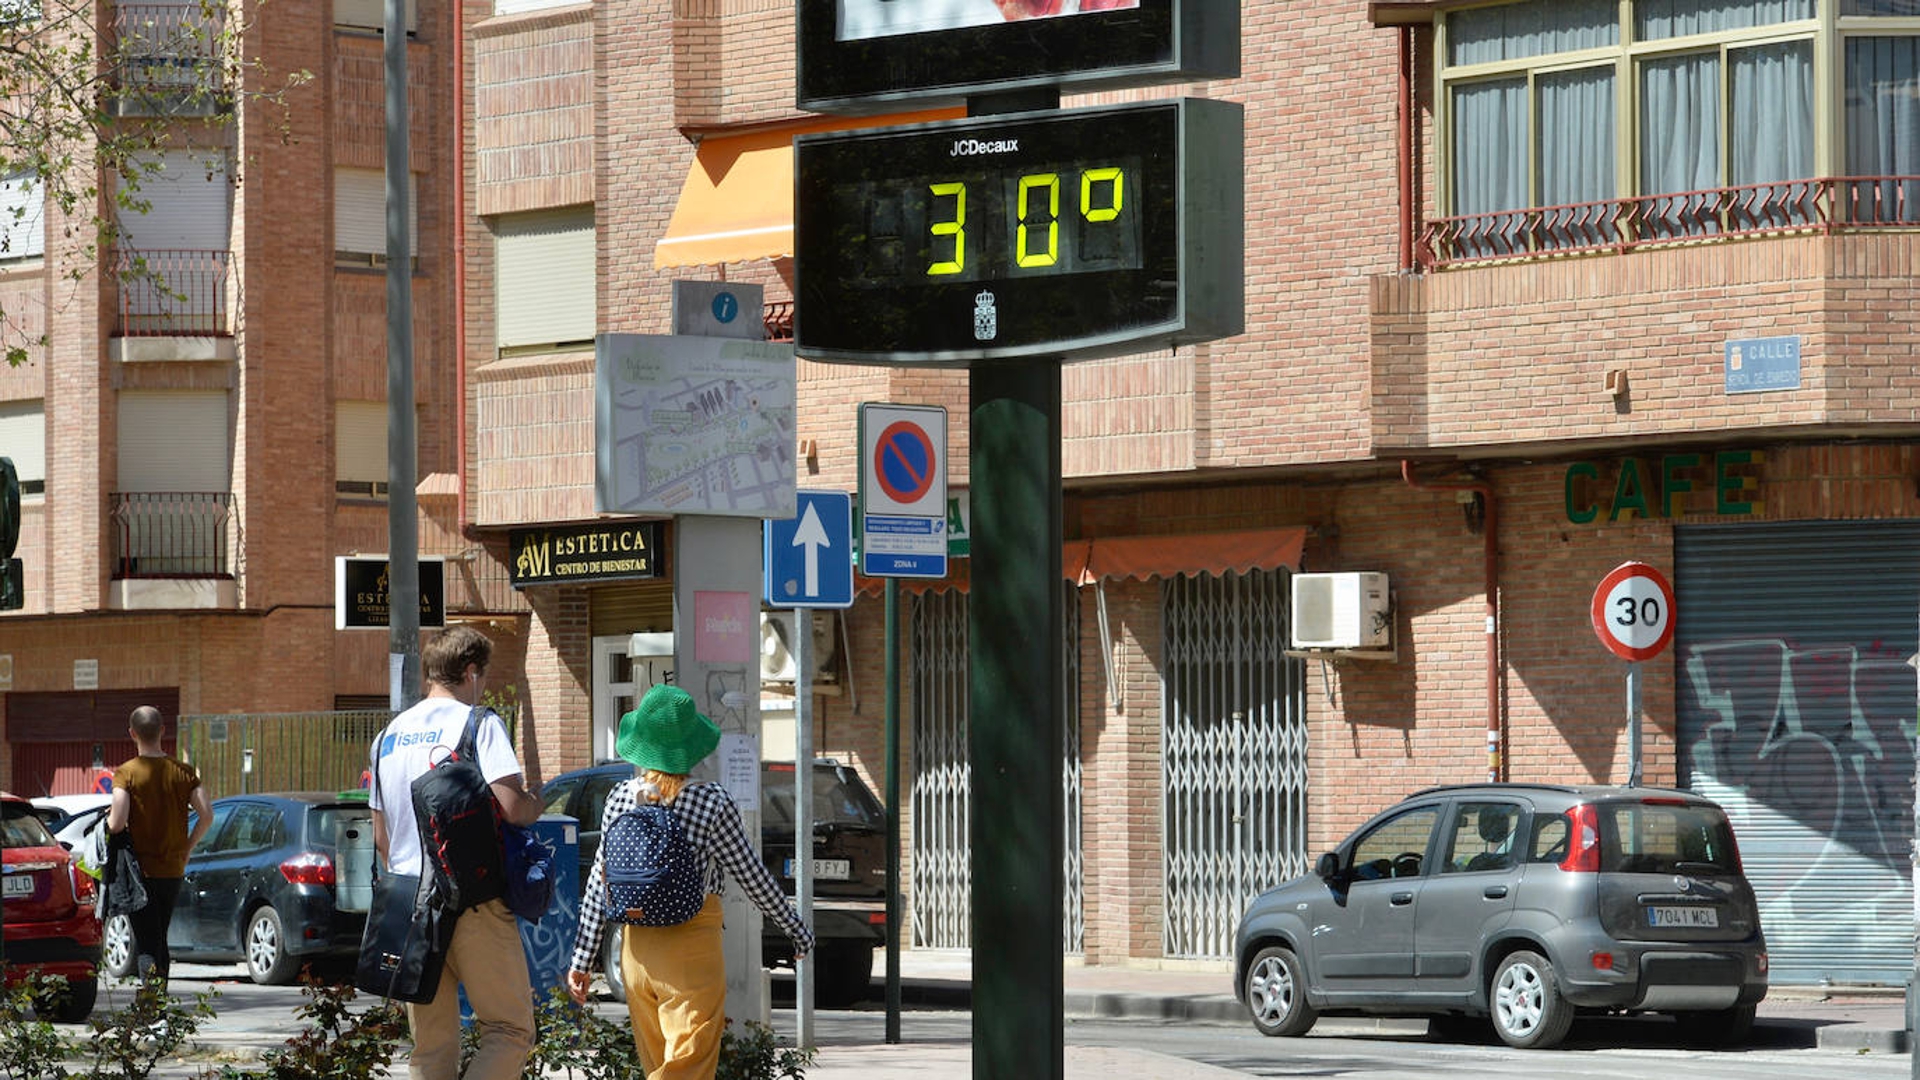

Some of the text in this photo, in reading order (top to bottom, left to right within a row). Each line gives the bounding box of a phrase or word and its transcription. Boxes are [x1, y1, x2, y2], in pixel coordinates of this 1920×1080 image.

[949, 138, 1018, 157] JCDecaux
[1750, 343, 1794, 360] CALLE
[555, 558, 647, 575] CENTRO DE BIENESTAR
[1616, 597, 1660, 627] 30
[397, 729, 444, 746] isaval
[824, 861, 847, 875] FYJ
[1656, 909, 1688, 924] 7041
[1691, 910, 1716, 925] MCL
